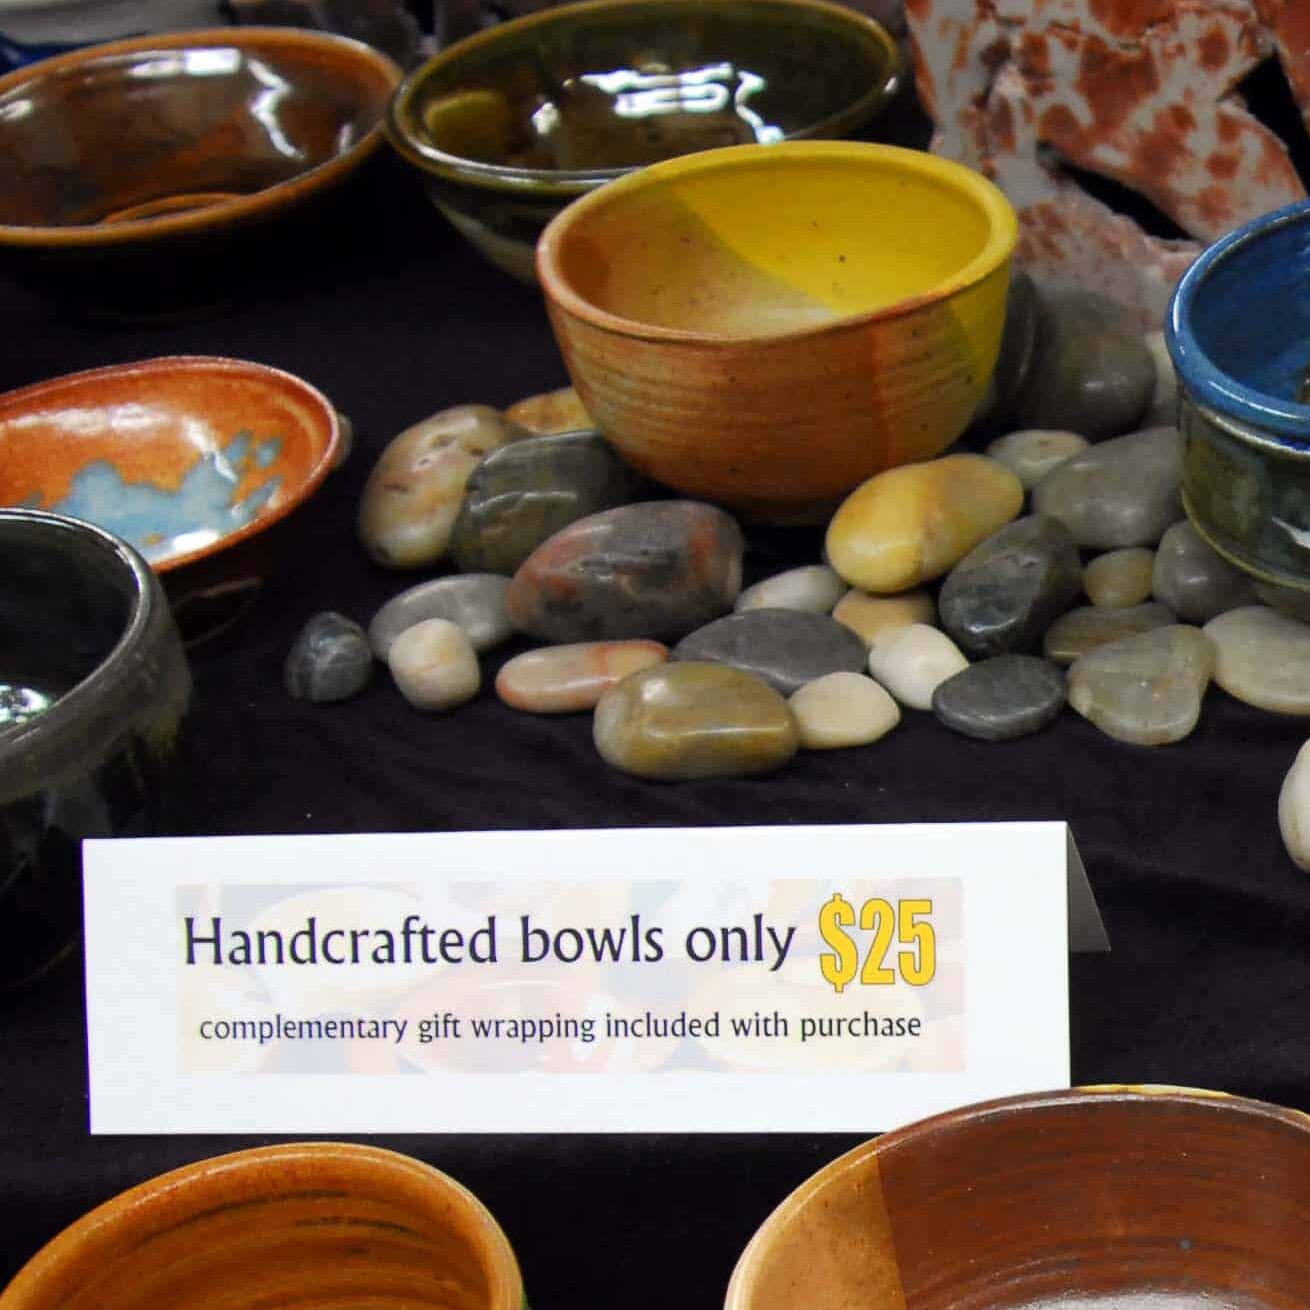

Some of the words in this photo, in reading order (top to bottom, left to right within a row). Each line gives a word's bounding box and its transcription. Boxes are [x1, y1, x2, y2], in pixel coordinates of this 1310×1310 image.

[183, 914, 499, 966] Handcrafted
[520, 913, 664, 964] bowls
[685, 912, 797, 972] only
[818, 893, 936, 994] $25
[198, 1012, 408, 1045] complementary
[418, 1011, 461, 1044] gift
[471, 1013, 596, 1043] wrapping
[605, 1010, 720, 1038] included
[730, 1010, 789, 1038] with
[800, 1010, 922, 1042] purchase
